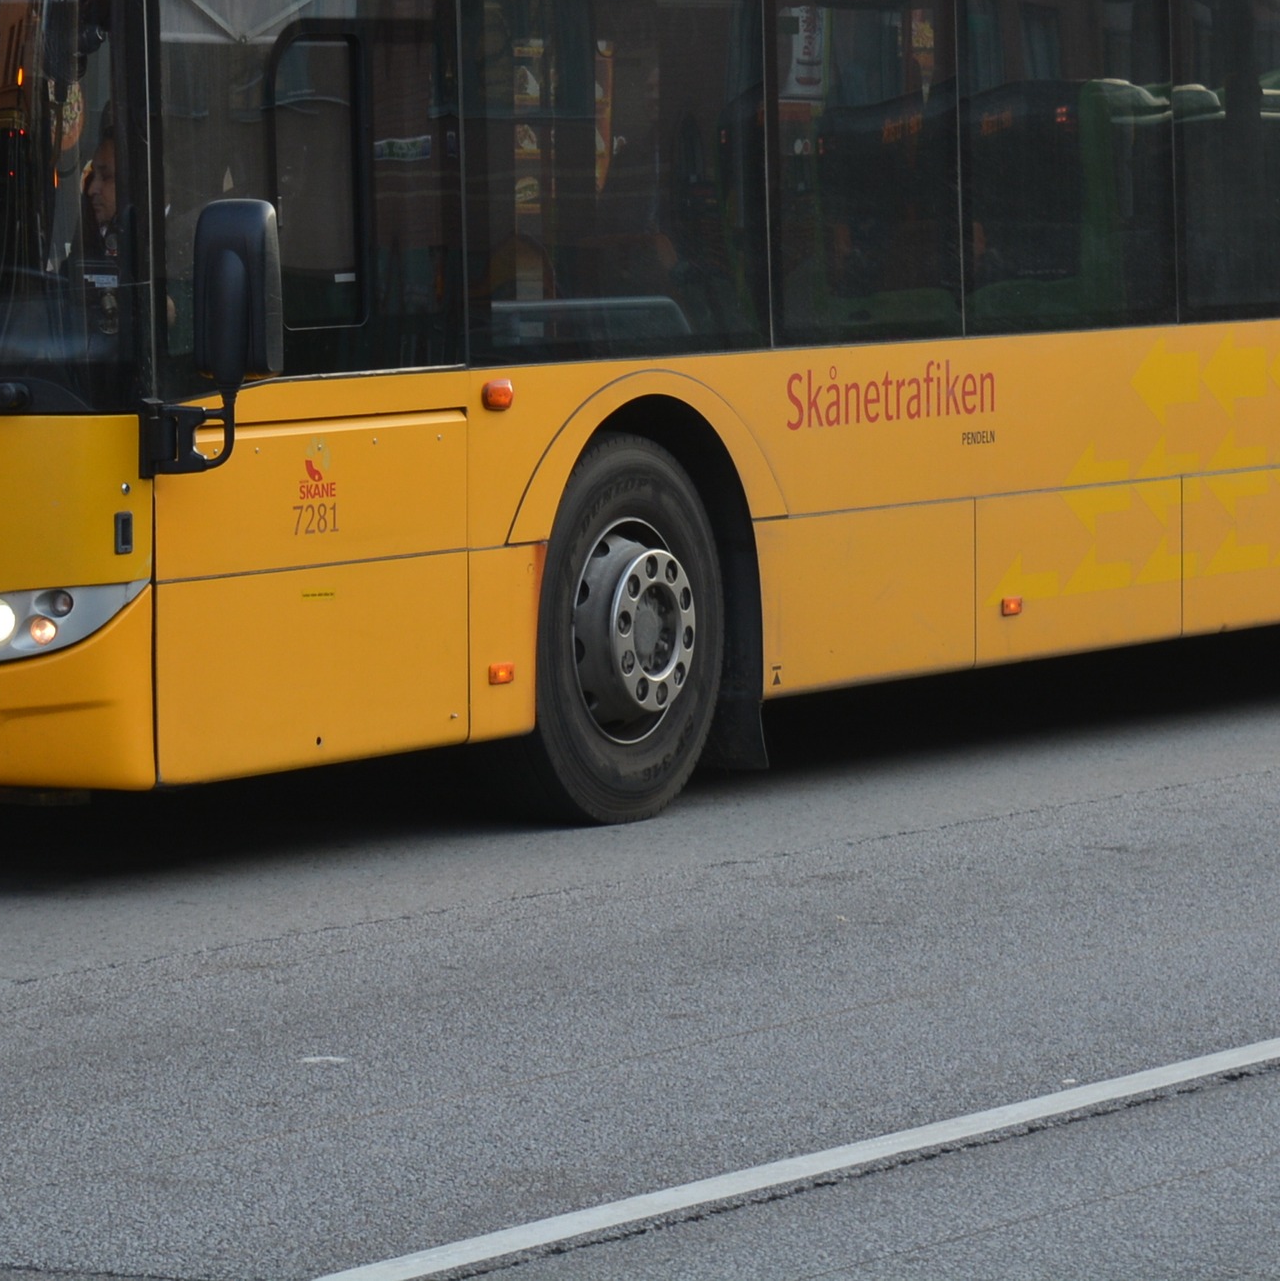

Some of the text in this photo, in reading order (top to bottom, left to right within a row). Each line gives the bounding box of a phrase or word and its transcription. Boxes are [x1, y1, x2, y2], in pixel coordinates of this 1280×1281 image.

[786, 359, 995, 431] Skånetrafiken
[961, 430, 995, 445] PENDELN
[292, 502, 340, 536] 7281
